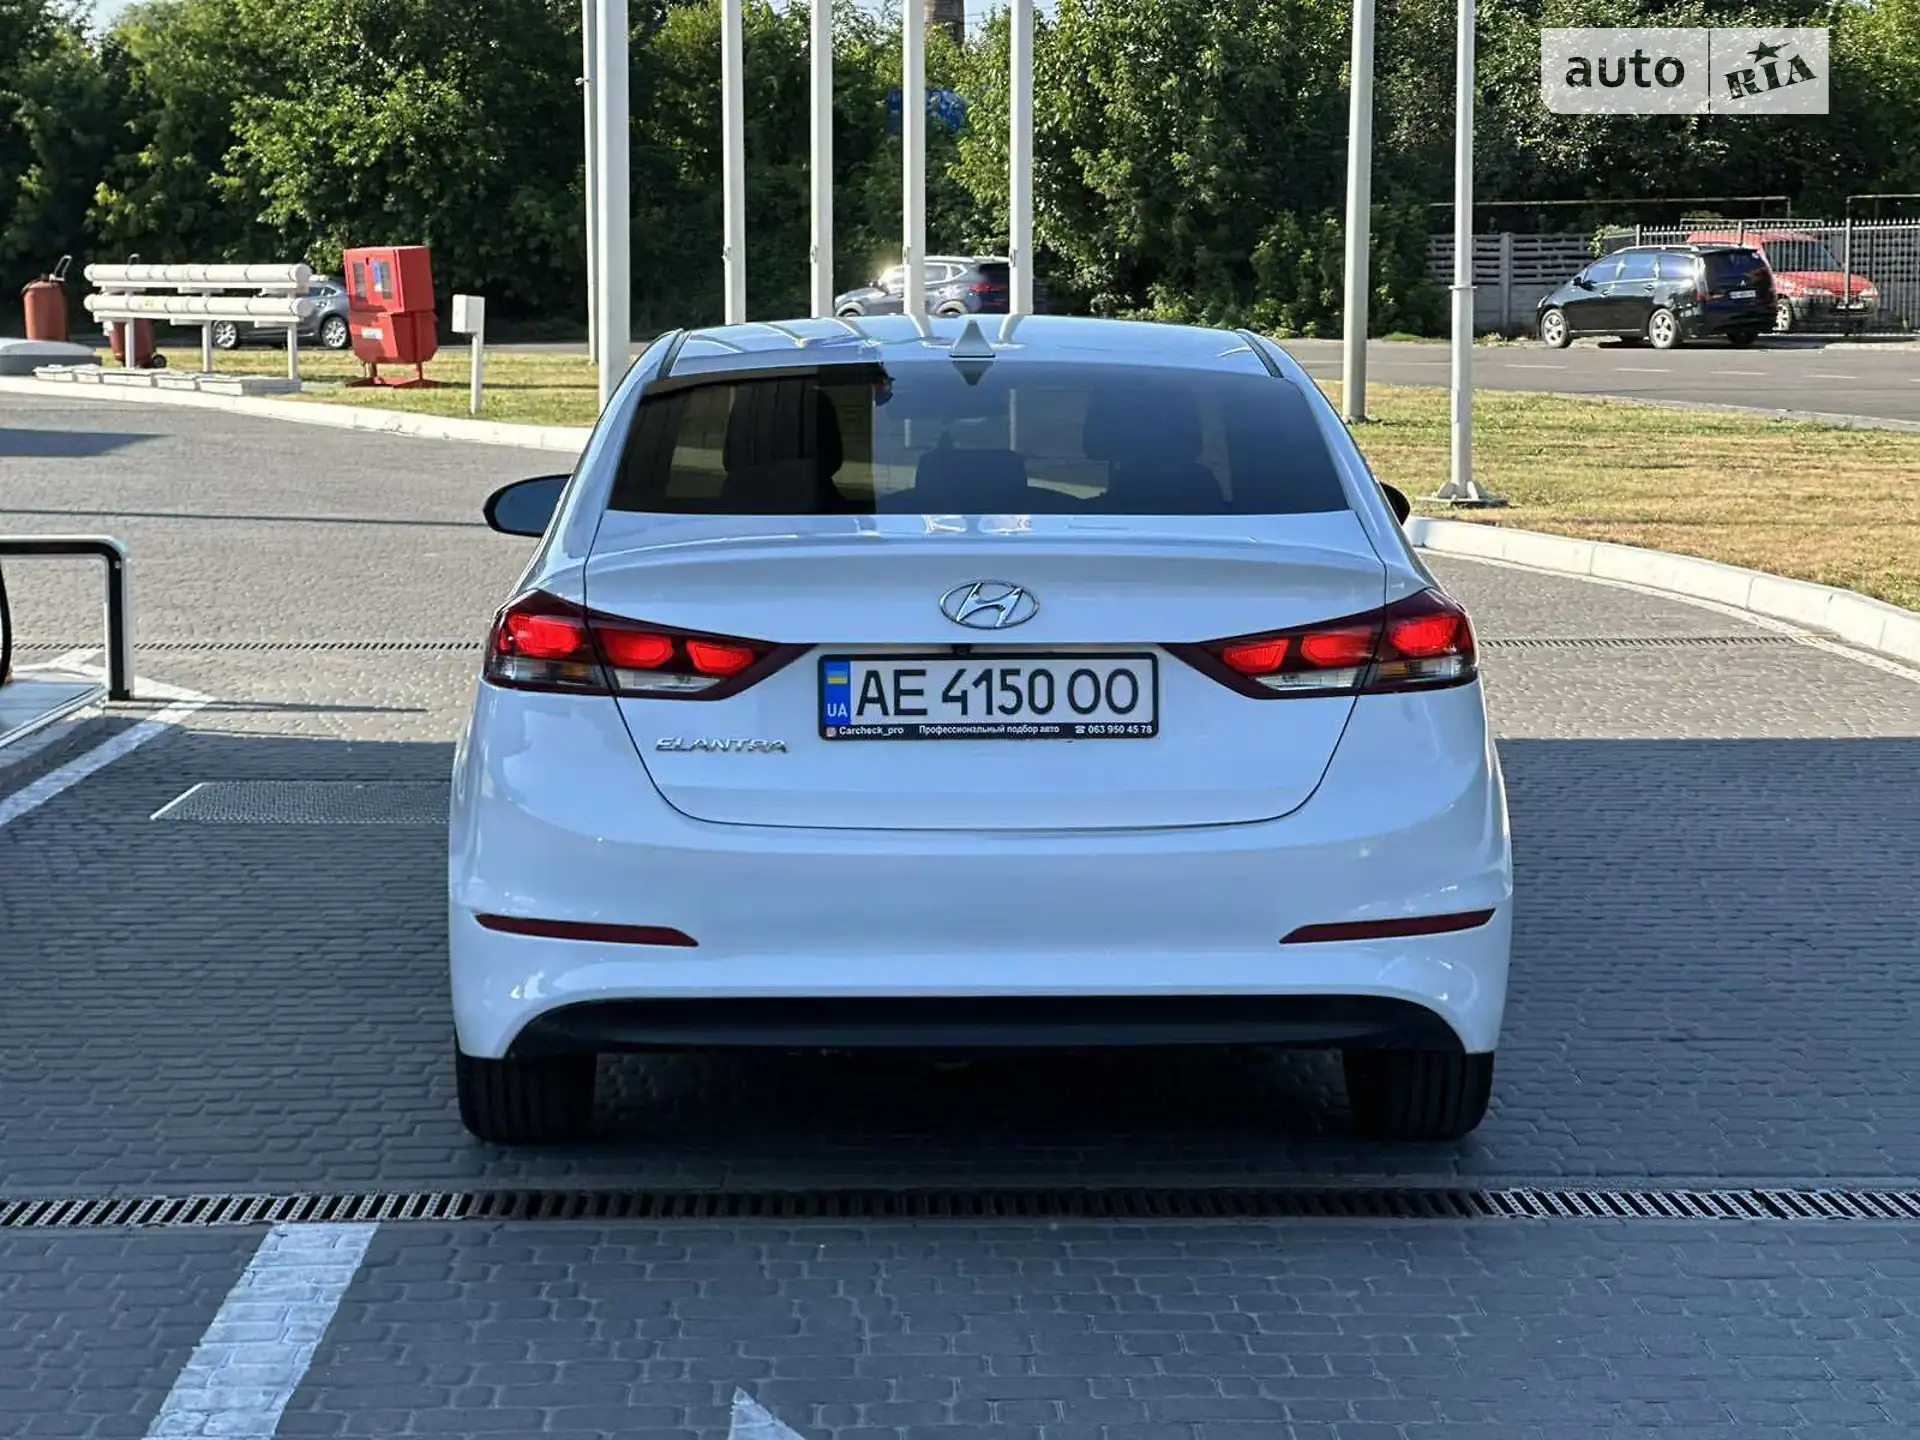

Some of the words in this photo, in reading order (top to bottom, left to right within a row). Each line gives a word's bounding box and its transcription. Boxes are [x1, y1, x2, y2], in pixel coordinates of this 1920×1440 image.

[856, 669, 928, 716] AE
[941, 668, 1055, 716] 4150
[1067, 668, 1139, 715] OO
[827, 703, 848, 718] UA
[839, 726, 905, 737] Carcheck_pro
[918, 725, 1005, 736] Профессиональный
[1007, 725, 1038, 735] подбор
[1039, 726, 1060, 734] авто
[1107, 725, 1125, 734] 950
[1126, 725, 1139, 734] 45
[1140, 725, 1153, 734] 78
[655, 736, 788, 754] ELANTRA
